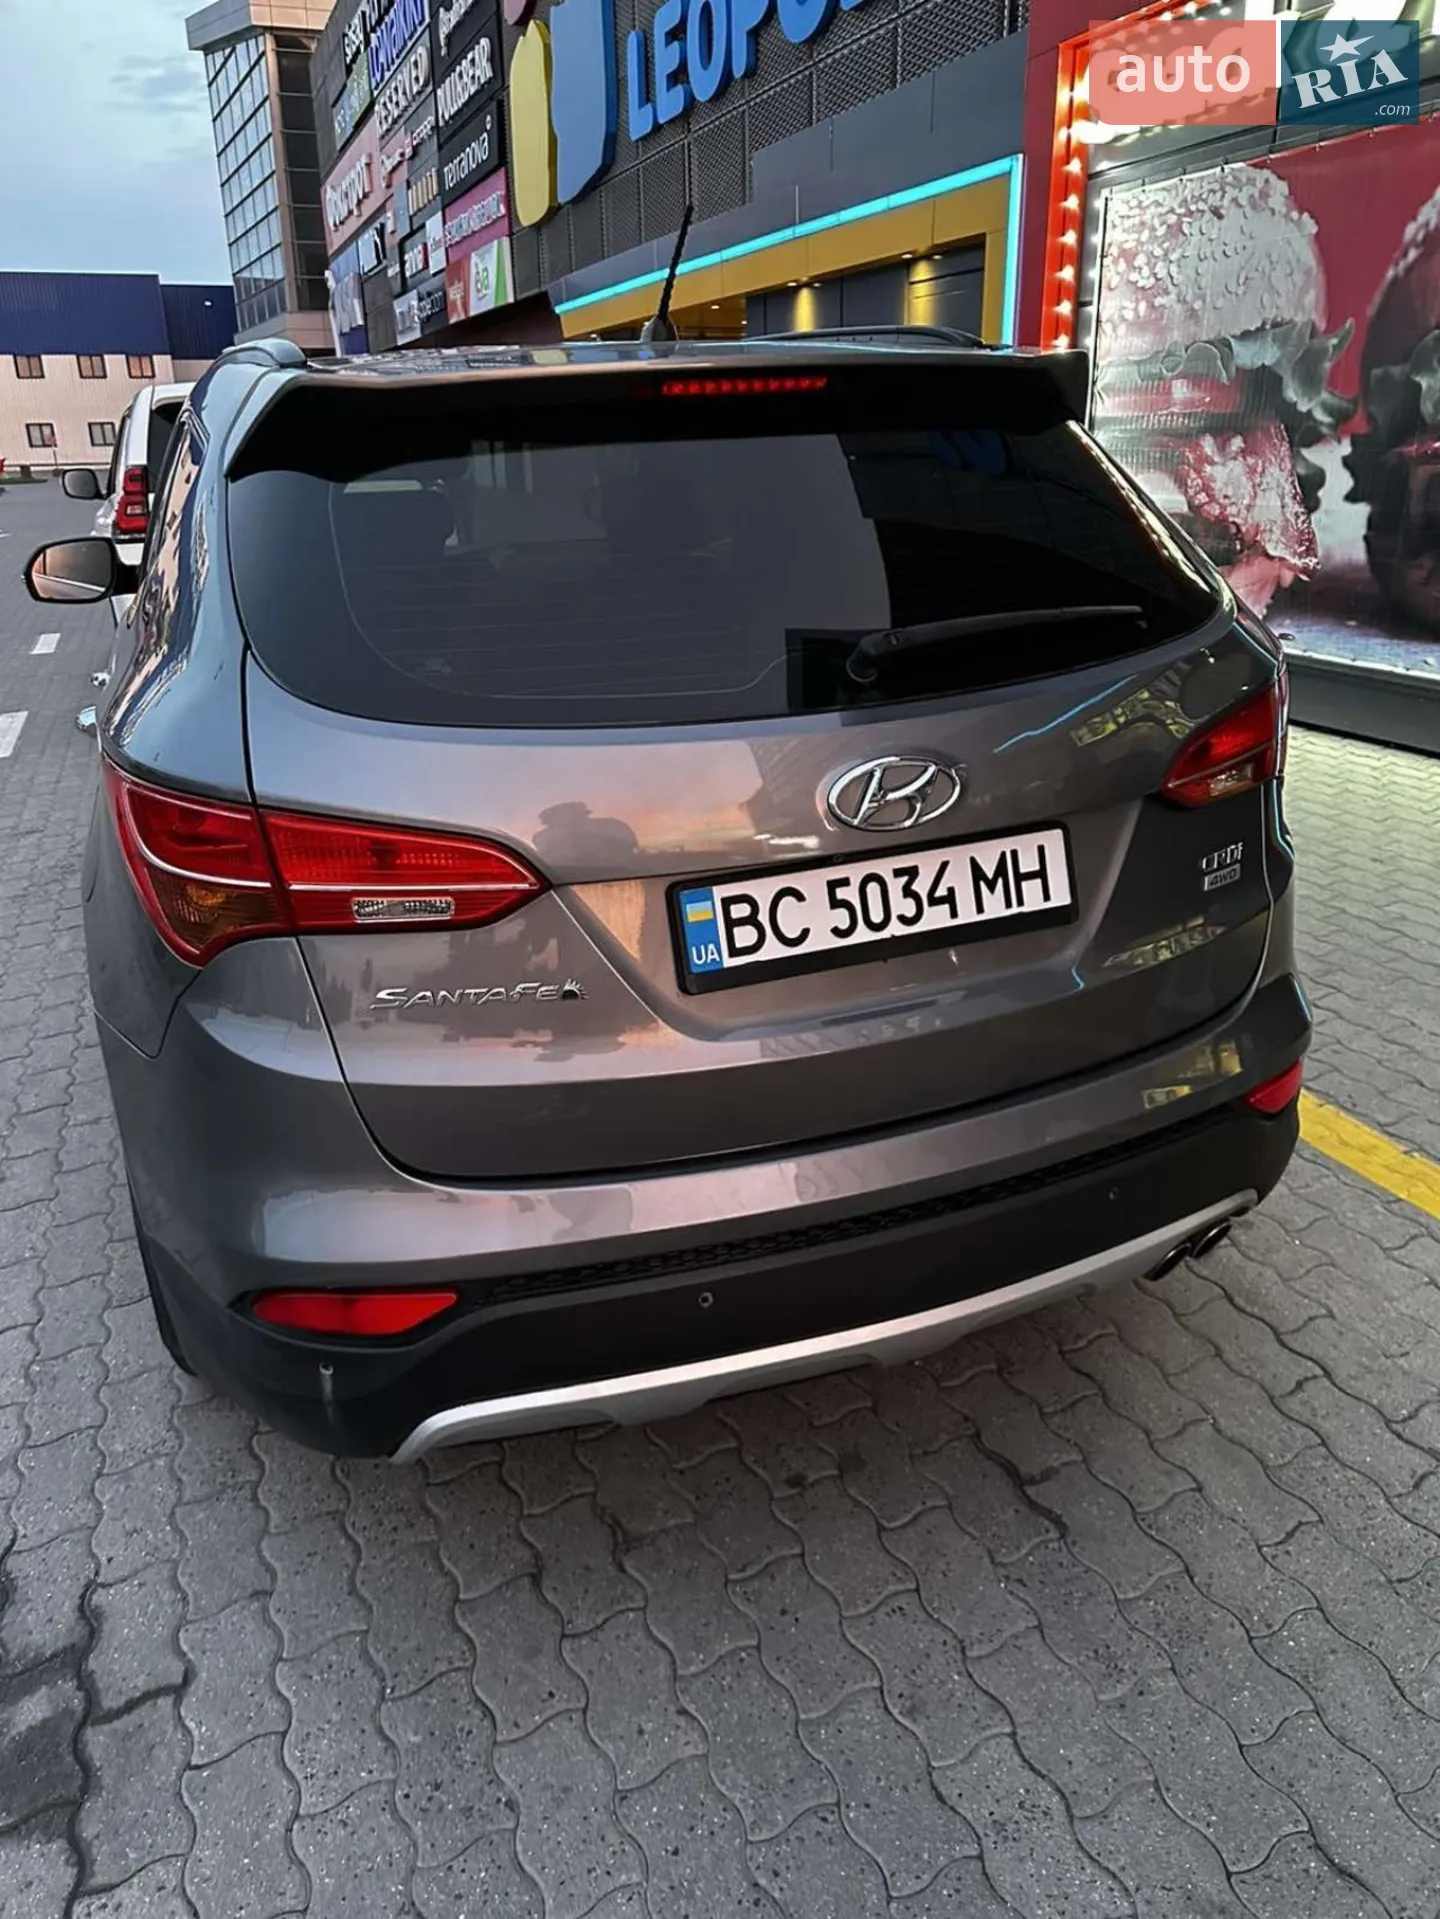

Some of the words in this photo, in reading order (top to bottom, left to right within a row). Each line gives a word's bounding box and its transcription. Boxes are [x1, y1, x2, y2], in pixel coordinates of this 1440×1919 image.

[374, 45, 430, 140] RESERVED
[719, 886, 811, 959] BC
[825, 859, 959, 939] 5034
[969, 843, 1052, 915] MH
[691, 944, 721, 965] UA
